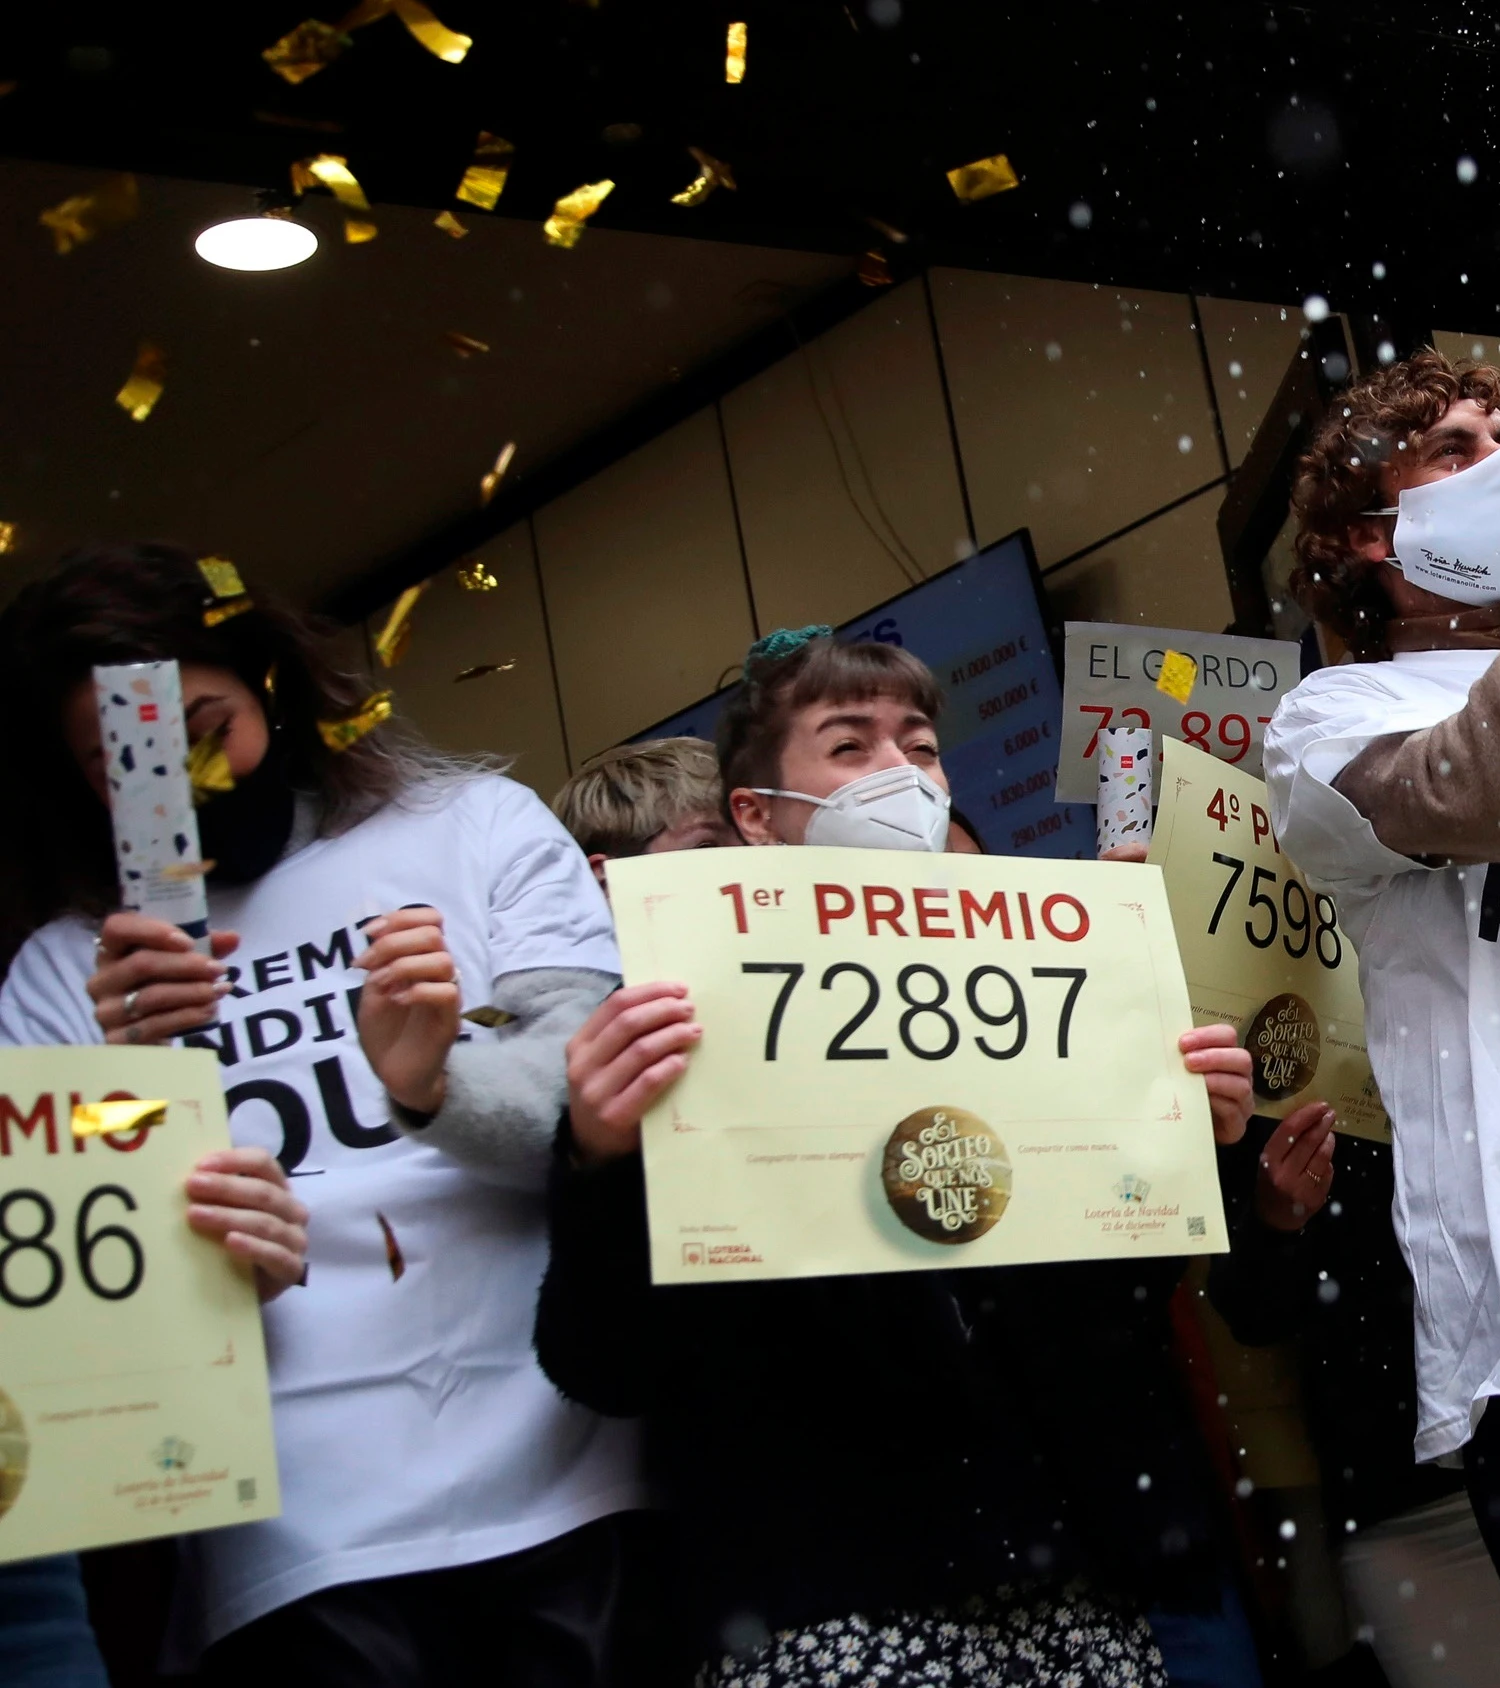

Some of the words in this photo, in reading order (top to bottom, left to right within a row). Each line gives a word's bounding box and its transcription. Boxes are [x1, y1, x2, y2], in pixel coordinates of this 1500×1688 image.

[1088, 644, 1130, 680] EL
[1003, 727, 1039, 757] 6.000
[1206, 787, 1241, 832] 4º
[813, 883, 1091, 944] PREMIO
[740, 962, 1088, 1063] 72897
[1123, 1206, 1135, 1217] de
[1138, 1204, 1180, 1217] Navidad
[0, 1183, 145, 1308] 86
